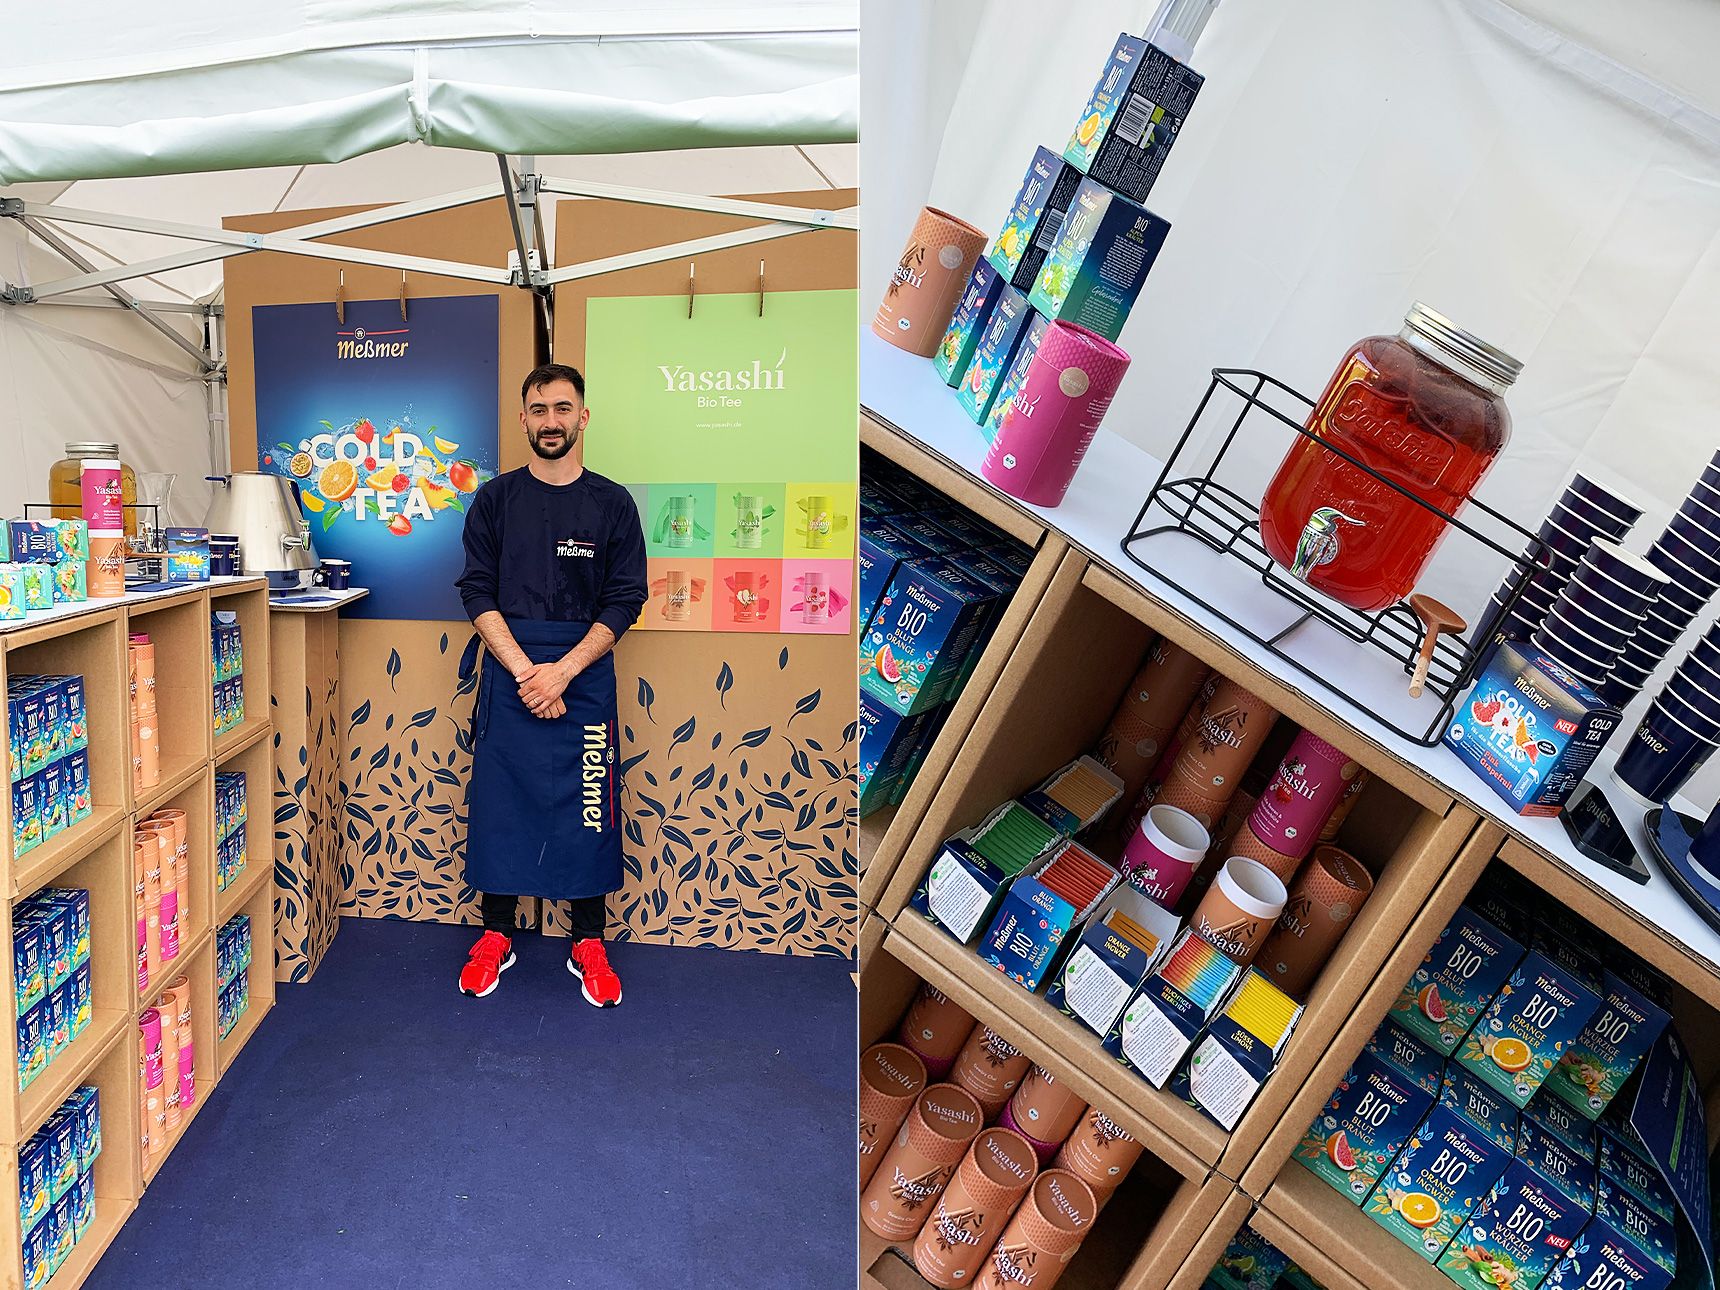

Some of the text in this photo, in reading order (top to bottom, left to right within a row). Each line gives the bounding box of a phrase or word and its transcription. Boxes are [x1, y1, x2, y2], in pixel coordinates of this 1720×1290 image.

[1102, 65, 1123, 94] BIO
[1022, 177, 1040, 206] BIO
[1067, 210, 1087, 240] BIO
[1134, 216, 1149, 233] BIO
[989, 315, 1007, 345] BIO
[337, 339, 409, 359] Meßmer
[697, 395, 742, 408] Bio Tee
[310, 433, 424, 468] COLD
[352, 486, 435, 521] TEA
[30, 535, 46, 550] BIO
[873, 529, 898, 544] BIO
[938, 569, 963, 584] BIO
[975, 562, 998, 576] BIO
[905, 585, 941, 613] Meßmer
[897, 602, 927, 636] BIO
[886, 633, 916, 657] ORANGE
[893, 628, 916, 645] BLUT-
[1513, 676, 1552, 711] Meßmer
[1495, 689, 1537, 728] COLD
[1556, 720, 1577, 734] NEU
[1585, 730, 1602, 742] TEA
[1589, 717, 1613, 731] COLD
[1489, 728, 1519, 761] TEA
[1484, 750, 1499, 768] Pink
[582, 722, 607, 833] Meßmer
[1480, 758, 1513, 790] Grapefruit
[1031, 895, 1054, 913] ORANGE
[1038, 890, 1055, 904] BLUT-
[993, 914, 1018, 952] Meßmer
[1008, 932, 1034, 959] BIO
[1106, 935, 1131, 954] ORANGE
[1459, 926, 1499, 957] Meßmer
[1032, 945, 1050, 970] ORANGE
[1104, 941, 1127, 960] INGWER
[1447, 943, 1482, 979] BIO
[1432, 971, 1467, 998] ORANGE
[1442, 968, 1467, 987] BLUT-
[1535, 976, 1576, 1008] Meßmer
[1521, 993, 1558, 1030] BIO
[1607, 993, 1646, 1024] Meßmer
[1507, 1022, 1541, 1049] INGWER
[1512, 1014, 1547, 1043] ORANGE
[1594, 1010, 1630, 1044] BIO
[1230, 1033, 1254, 1053] LIMONE
[1393, 1040, 1415, 1063] BIO
[1578, 1035, 1615, 1064] KRÄUTER
[1584, 1027, 1621, 1058] WÜRZIGE
[1367, 1073, 1408, 1106] Meßmer
[1463, 1080, 1500, 1110] Meßmer
[1355, 1091, 1392, 1127] BIO
[1468, 1094, 1491, 1119] BIO
[1549, 1106, 1570, 1130] BIO
[1341, 1119, 1376, 1147] ORANGE
[1350, 1115, 1377, 1136] BLUT-
[1443, 1131, 1485, 1164] Meßmer
[1430, 1148, 1468, 1186] BIO
[1545, 1151, 1568, 1176] BIO
[1627, 1164, 1649, 1189] BIO
[1416, 1177, 1450, 1205] INGWER
[1420, 1169, 1457, 1199] ORANGE
[1519, 1185, 1562, 1221] Meßmer
[1506, 1203, 1544, 1242] BIO
[1625, 1209, 1649, 1236] BIO
[1489, 1230, 1528, 1264] KRÄUTER
[1495, 1221, 1535, 1257] WÜRZIGE
[1547, 1235, 1569, 1248] NEU
[1586, 1263, 1626, 1290] BIO
[1599, 1244, 1644, 1282] Meßmer
